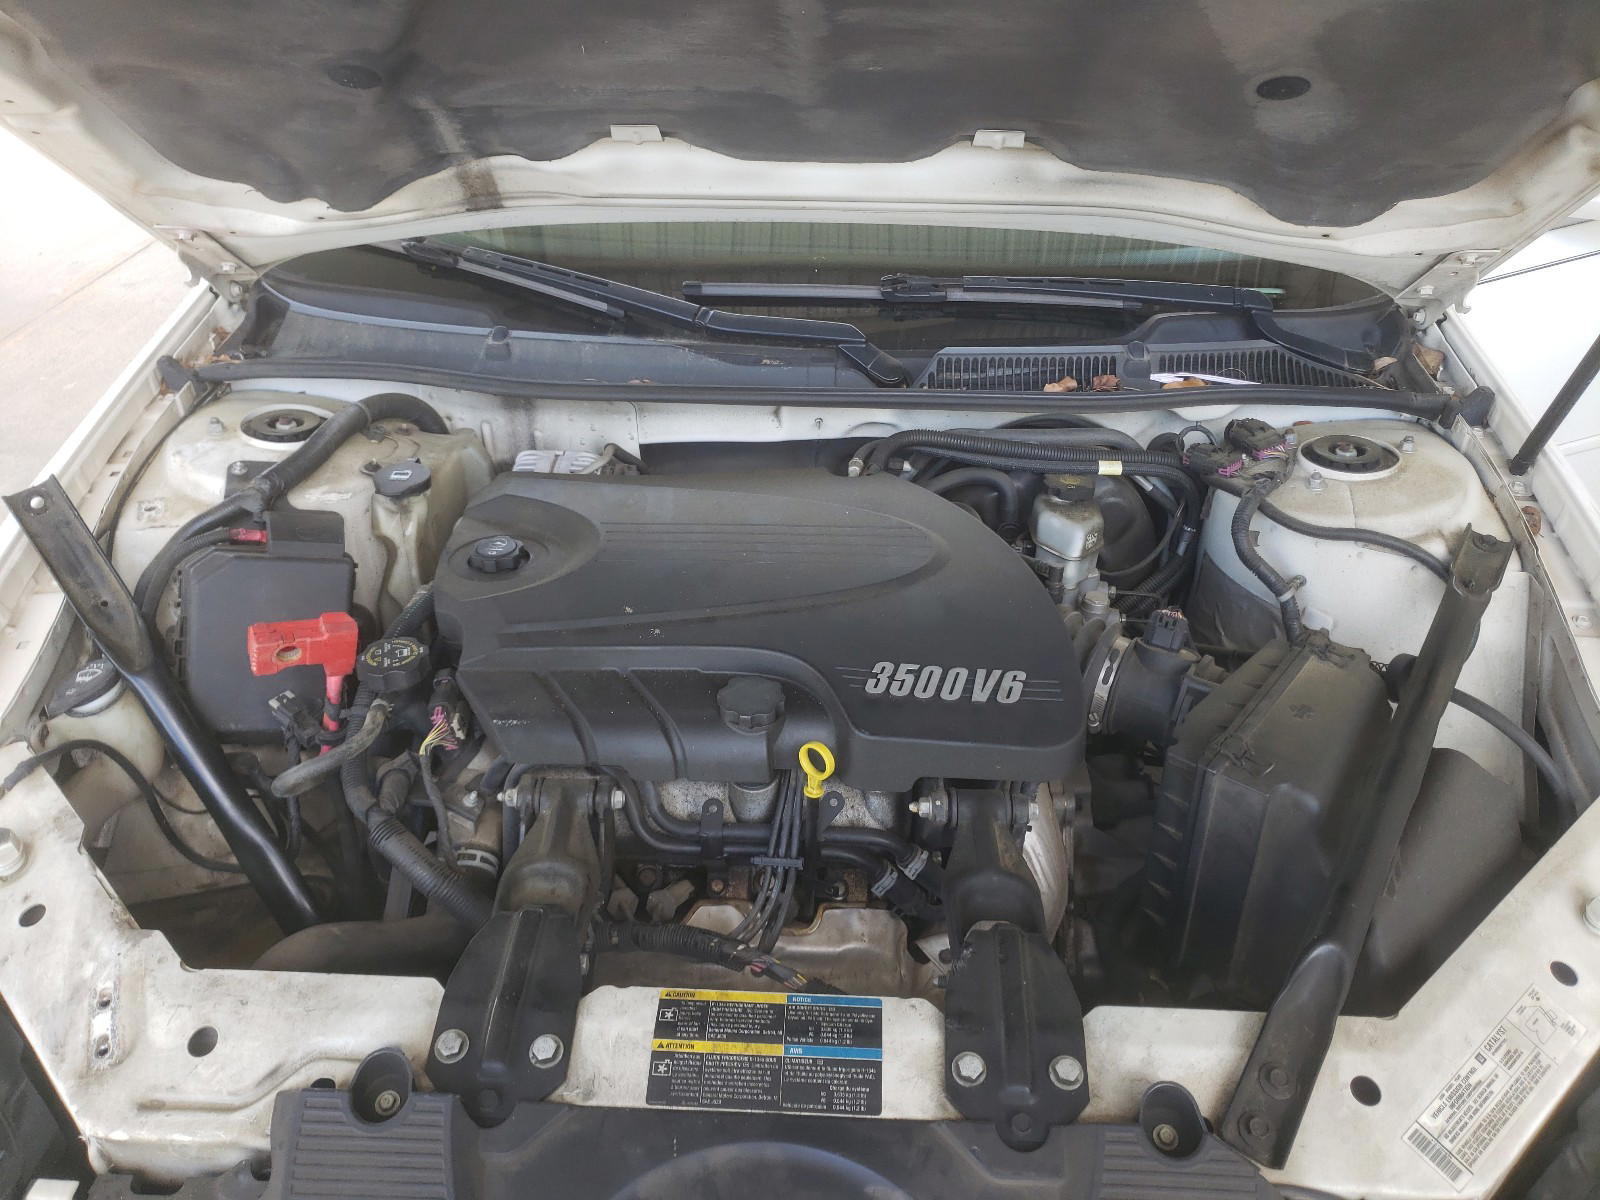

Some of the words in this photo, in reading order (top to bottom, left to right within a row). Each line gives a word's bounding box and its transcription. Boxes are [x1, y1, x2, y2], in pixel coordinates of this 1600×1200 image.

[865, 661, 969, 701] 3500
[971, 668, 1027, 704] V6
[665, 1042, 695, 1050] ATTENTION
[1483, 1024, 1508, 1052] CATALYST
[1431, 1099, 1448, 1120] VEHICLE
